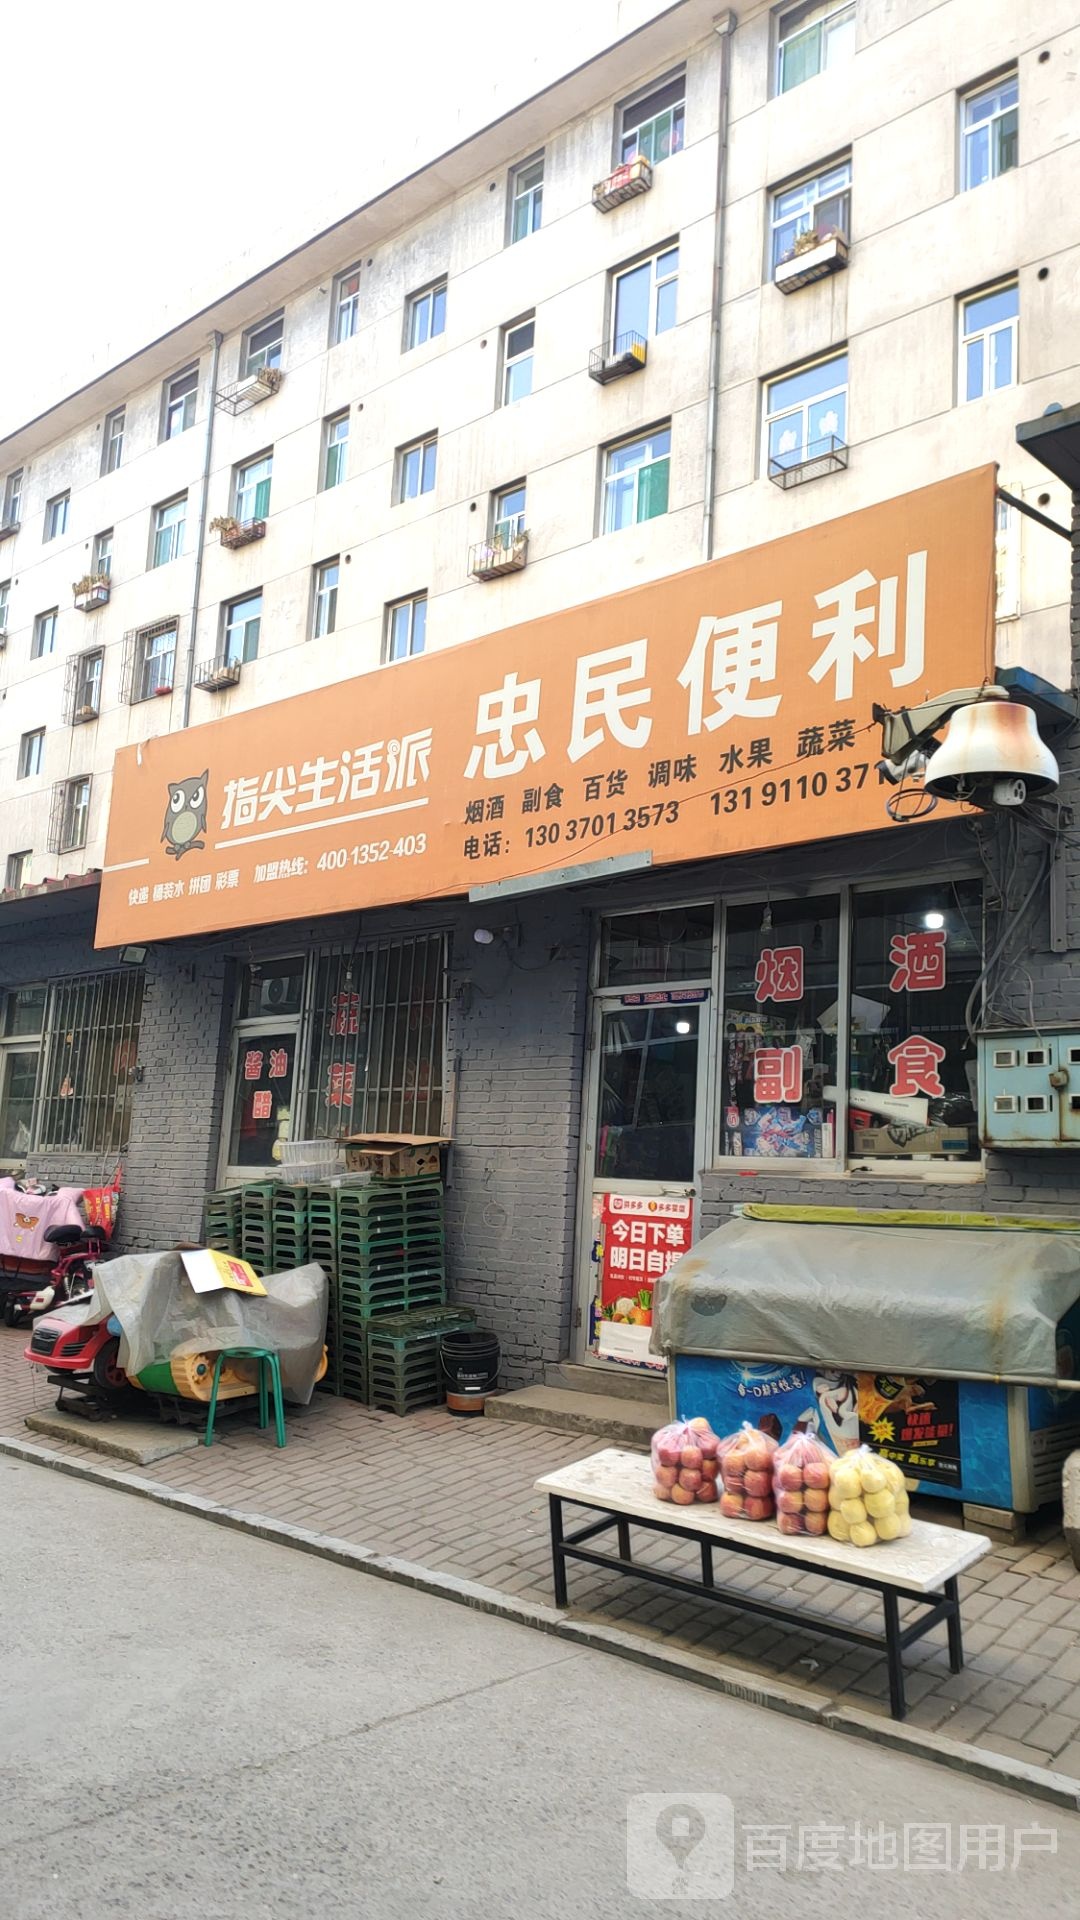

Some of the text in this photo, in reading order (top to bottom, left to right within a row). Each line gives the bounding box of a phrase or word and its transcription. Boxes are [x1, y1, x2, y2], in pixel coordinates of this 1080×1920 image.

[463, 551, 927, 780] 忠民便利
[219, 727, 433, 830] 指尖生活派
[464, 719, 856, 826] 烟酒 副食 百货 调味 水果 蔬菜
[463, 829, 511, 861] 电话：
[188, 875, 212, 896] 拼团
[215, 869, 240, 891] 彩票
[612, 1219, 685, 1247] 今日下单
